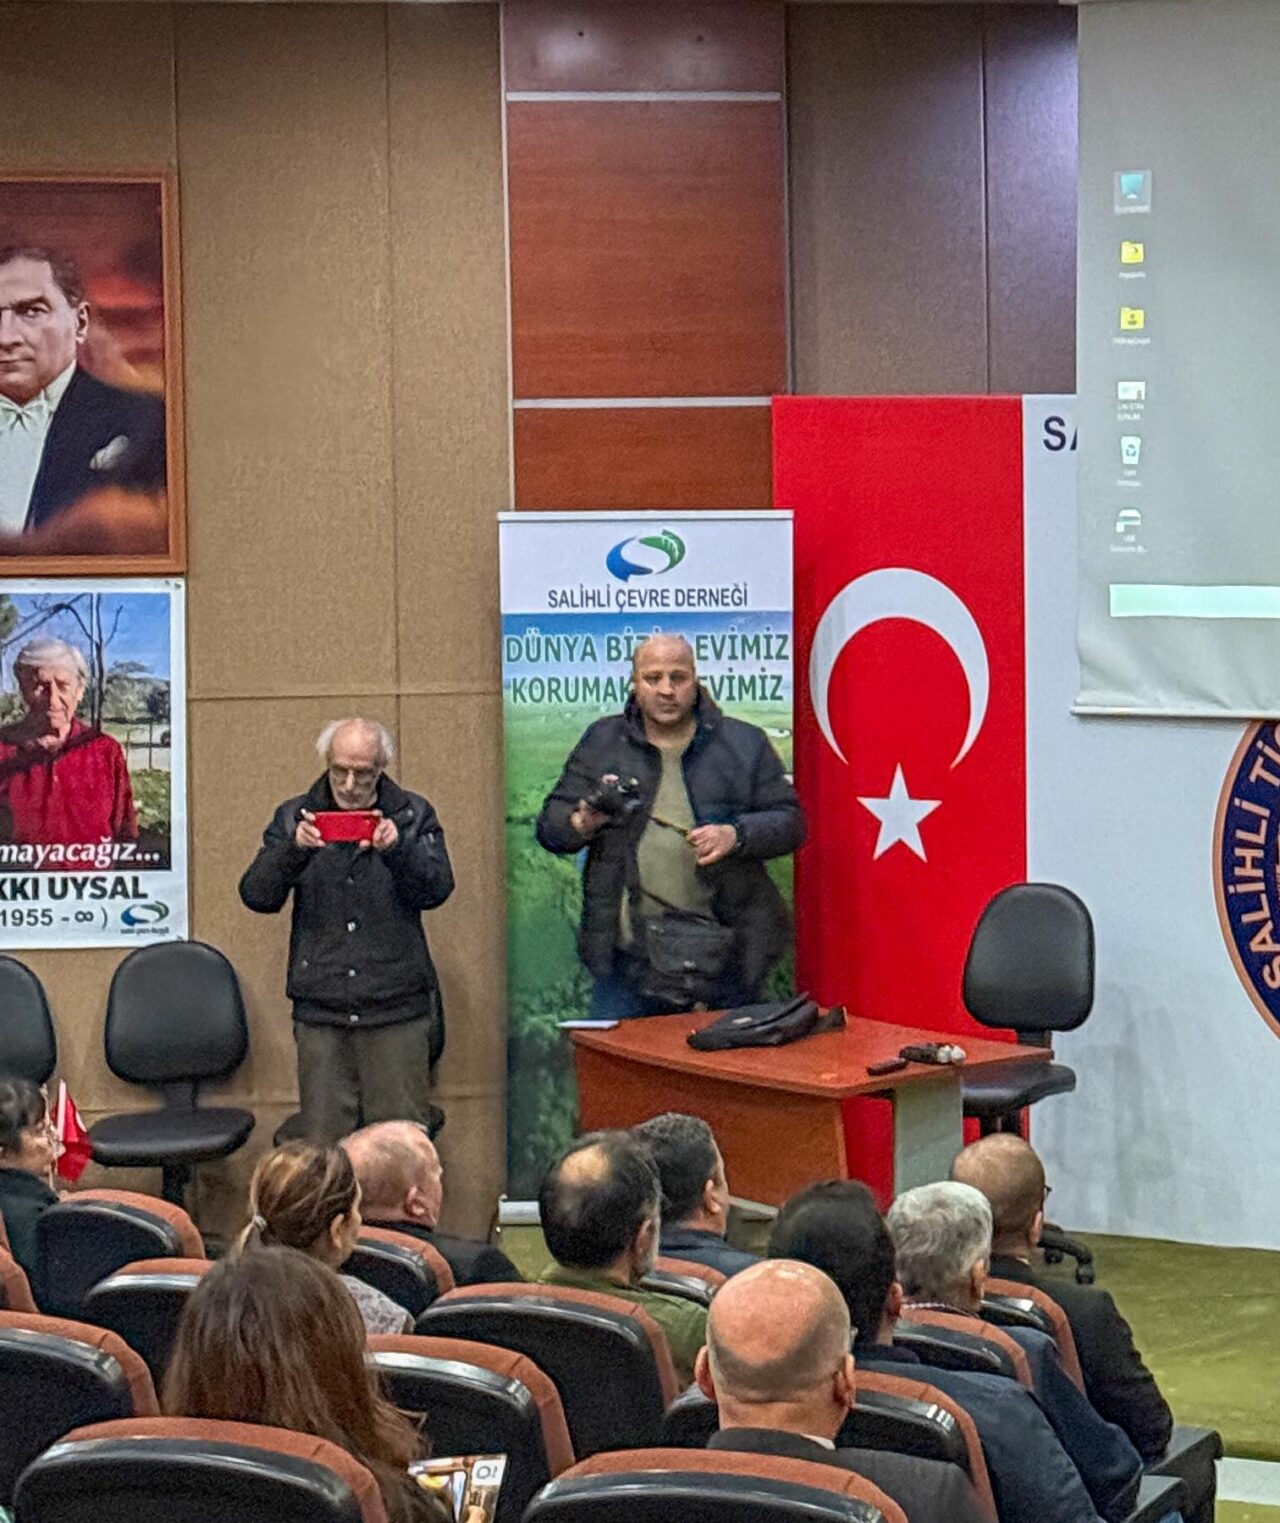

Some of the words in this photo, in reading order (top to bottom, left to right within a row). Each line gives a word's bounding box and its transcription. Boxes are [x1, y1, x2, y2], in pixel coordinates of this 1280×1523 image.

[548, 583, 611, 609] SALİHLİ
[615, 588, 671, 613] ÇEVRE
[675, 581, 748, 607] DERNEĞİ
[505, 627, 598, 663] DÜNYA
[695, 626, 790, 661] EVİMİZ
[48, 876, 148, 900] UYSAL
